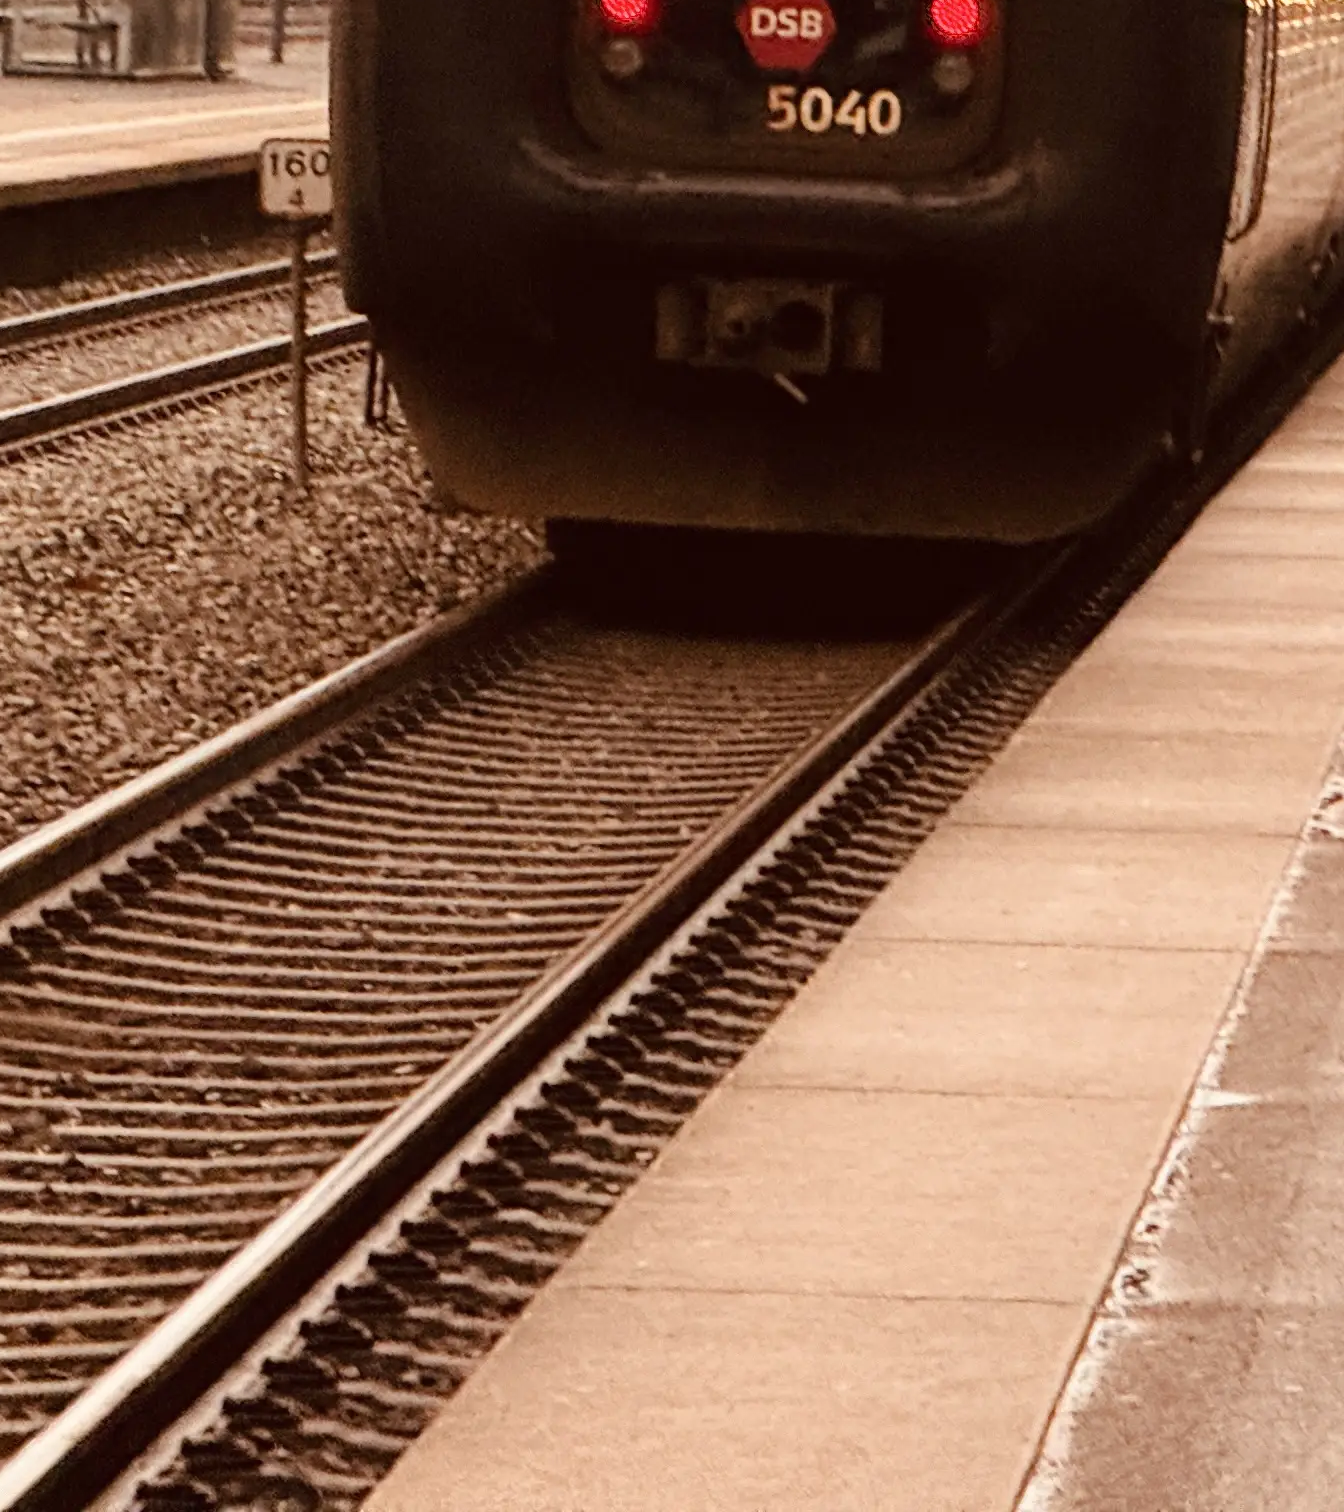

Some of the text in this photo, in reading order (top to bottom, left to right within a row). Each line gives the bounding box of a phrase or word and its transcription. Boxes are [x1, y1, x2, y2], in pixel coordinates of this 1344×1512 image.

[750, 6, 824, 40] DSB
[766, 84, 902, 135] 5040
[270, 150, 331, 177] 160
